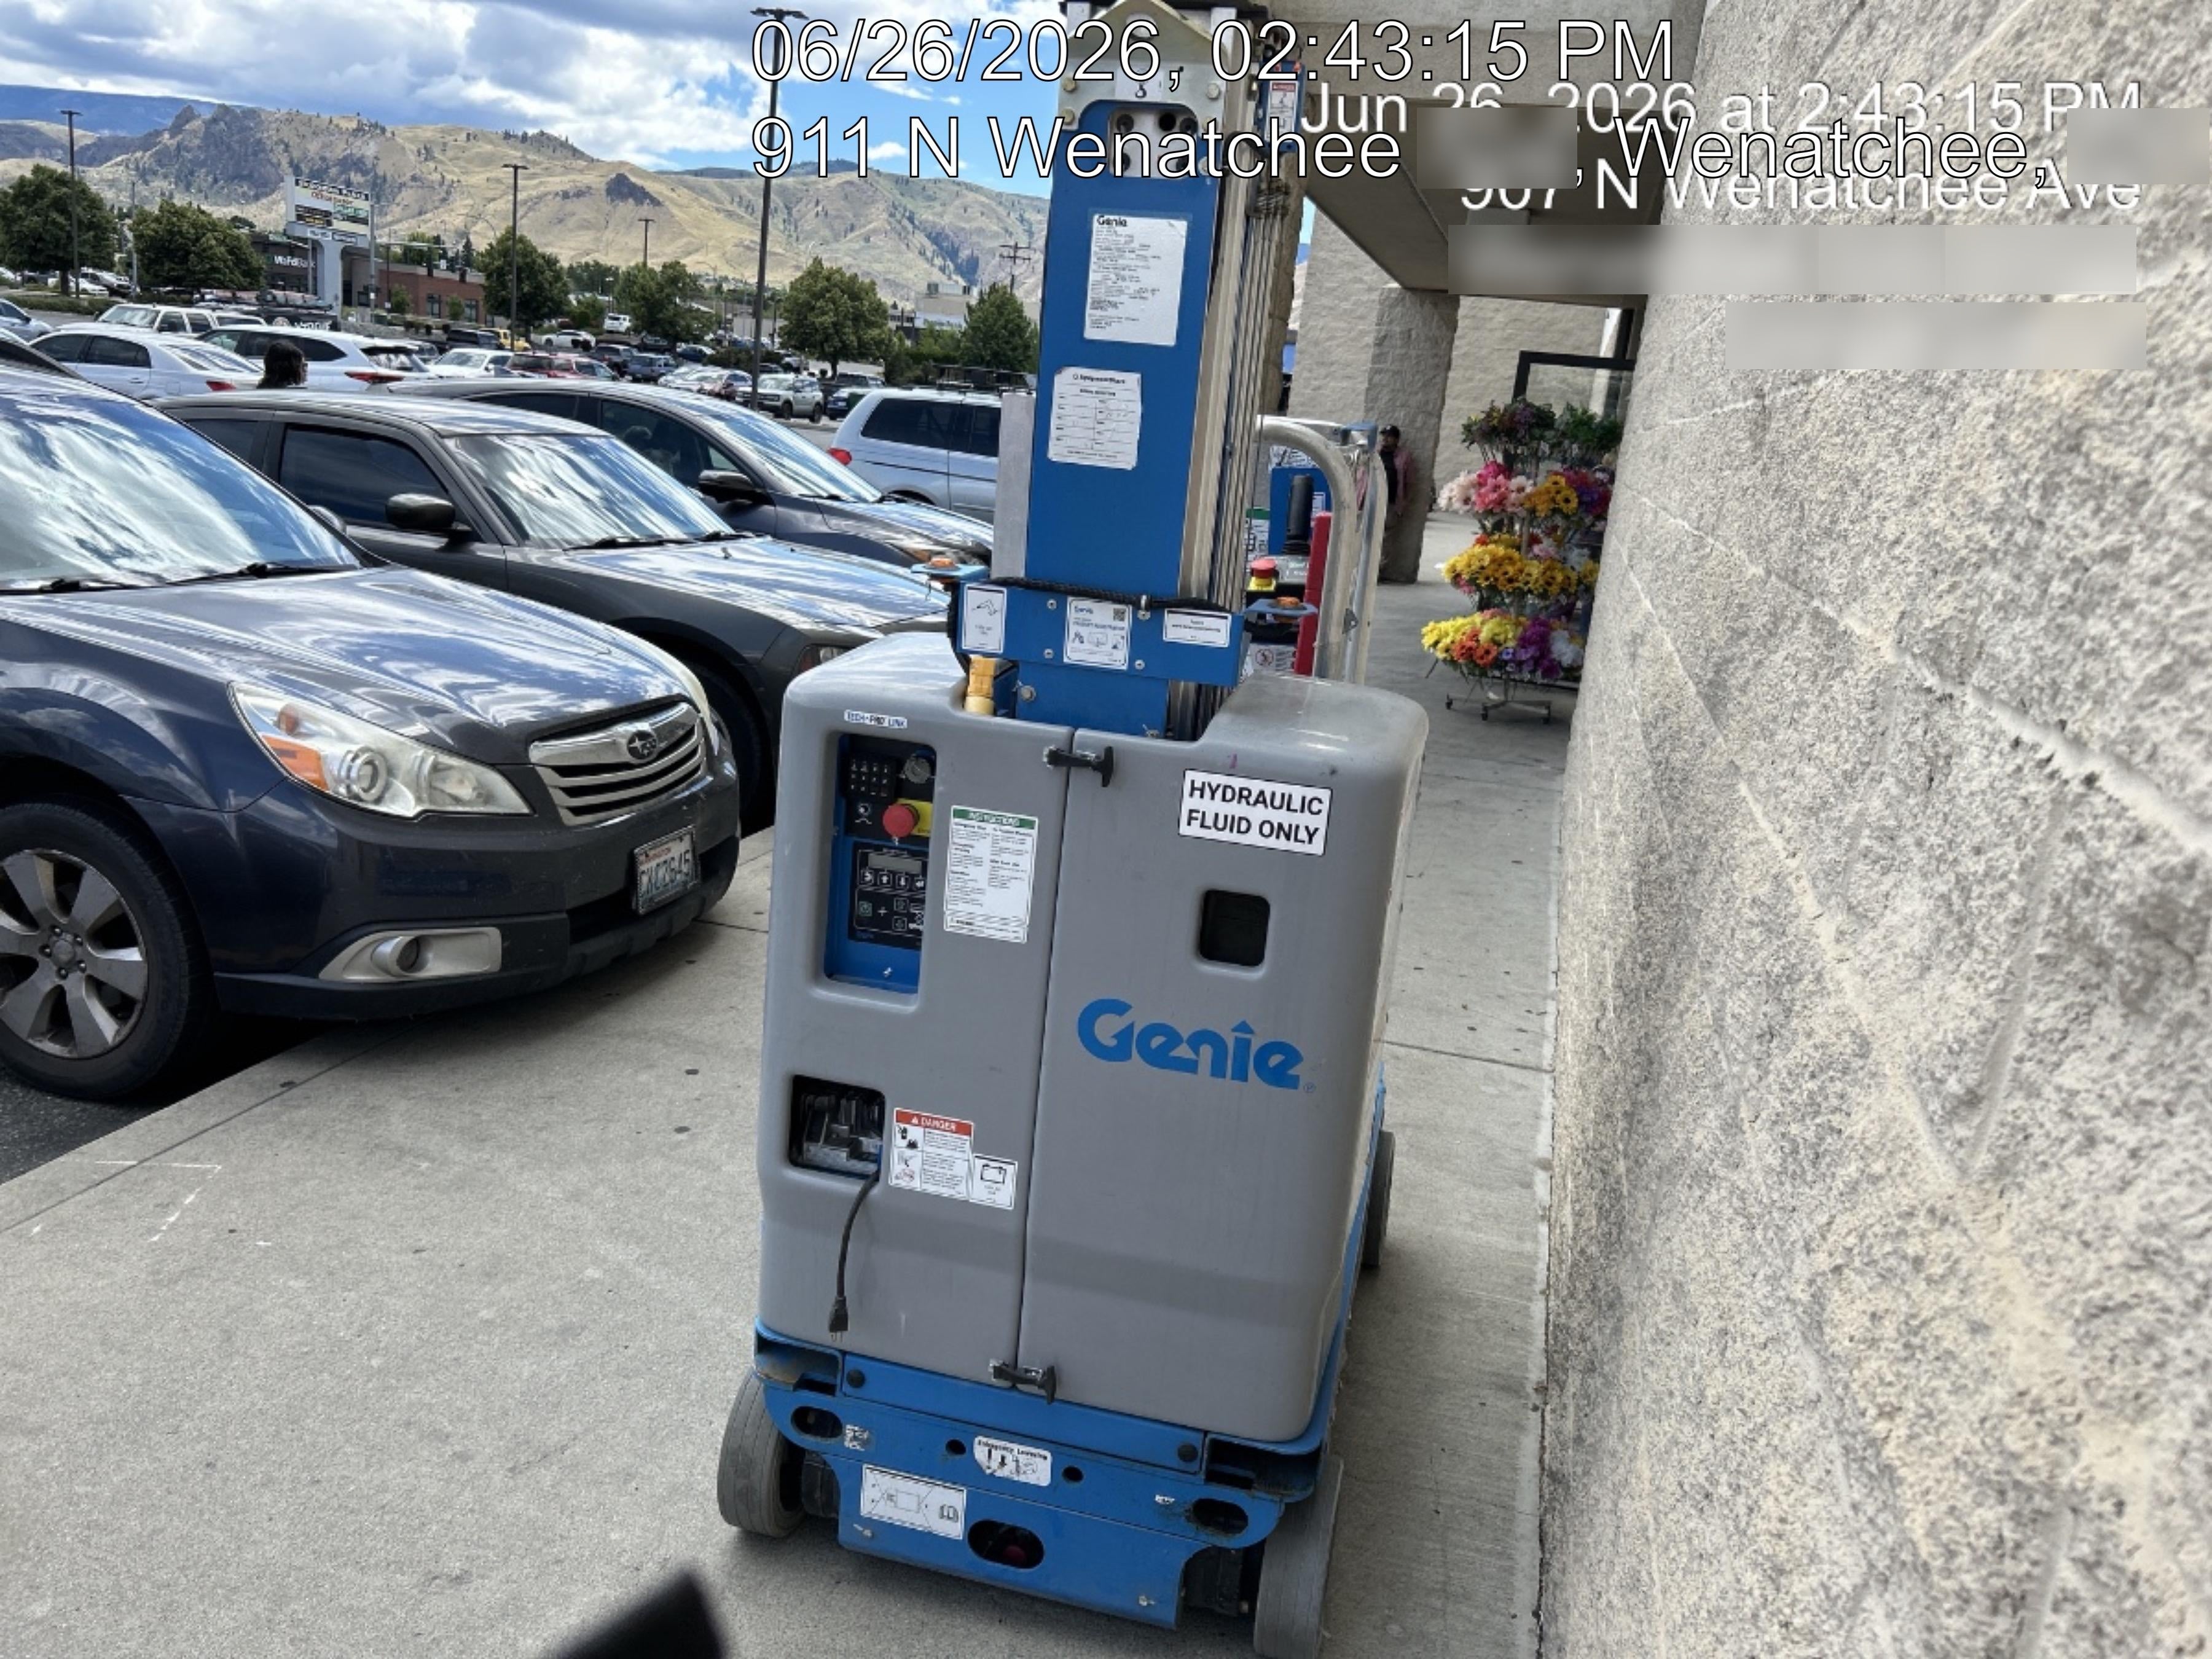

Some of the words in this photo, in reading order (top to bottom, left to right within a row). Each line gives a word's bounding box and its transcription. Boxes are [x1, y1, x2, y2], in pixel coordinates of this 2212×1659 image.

[1188, 779, 1324, 816] HYDRAULIC
[1186, 809, 1252, 834] FLUID
[1258, 820, 1319, 845] ONLY
[1078, 998, 1304, 1091] Genie
[922, 1116, 956, 1131] DANGER
